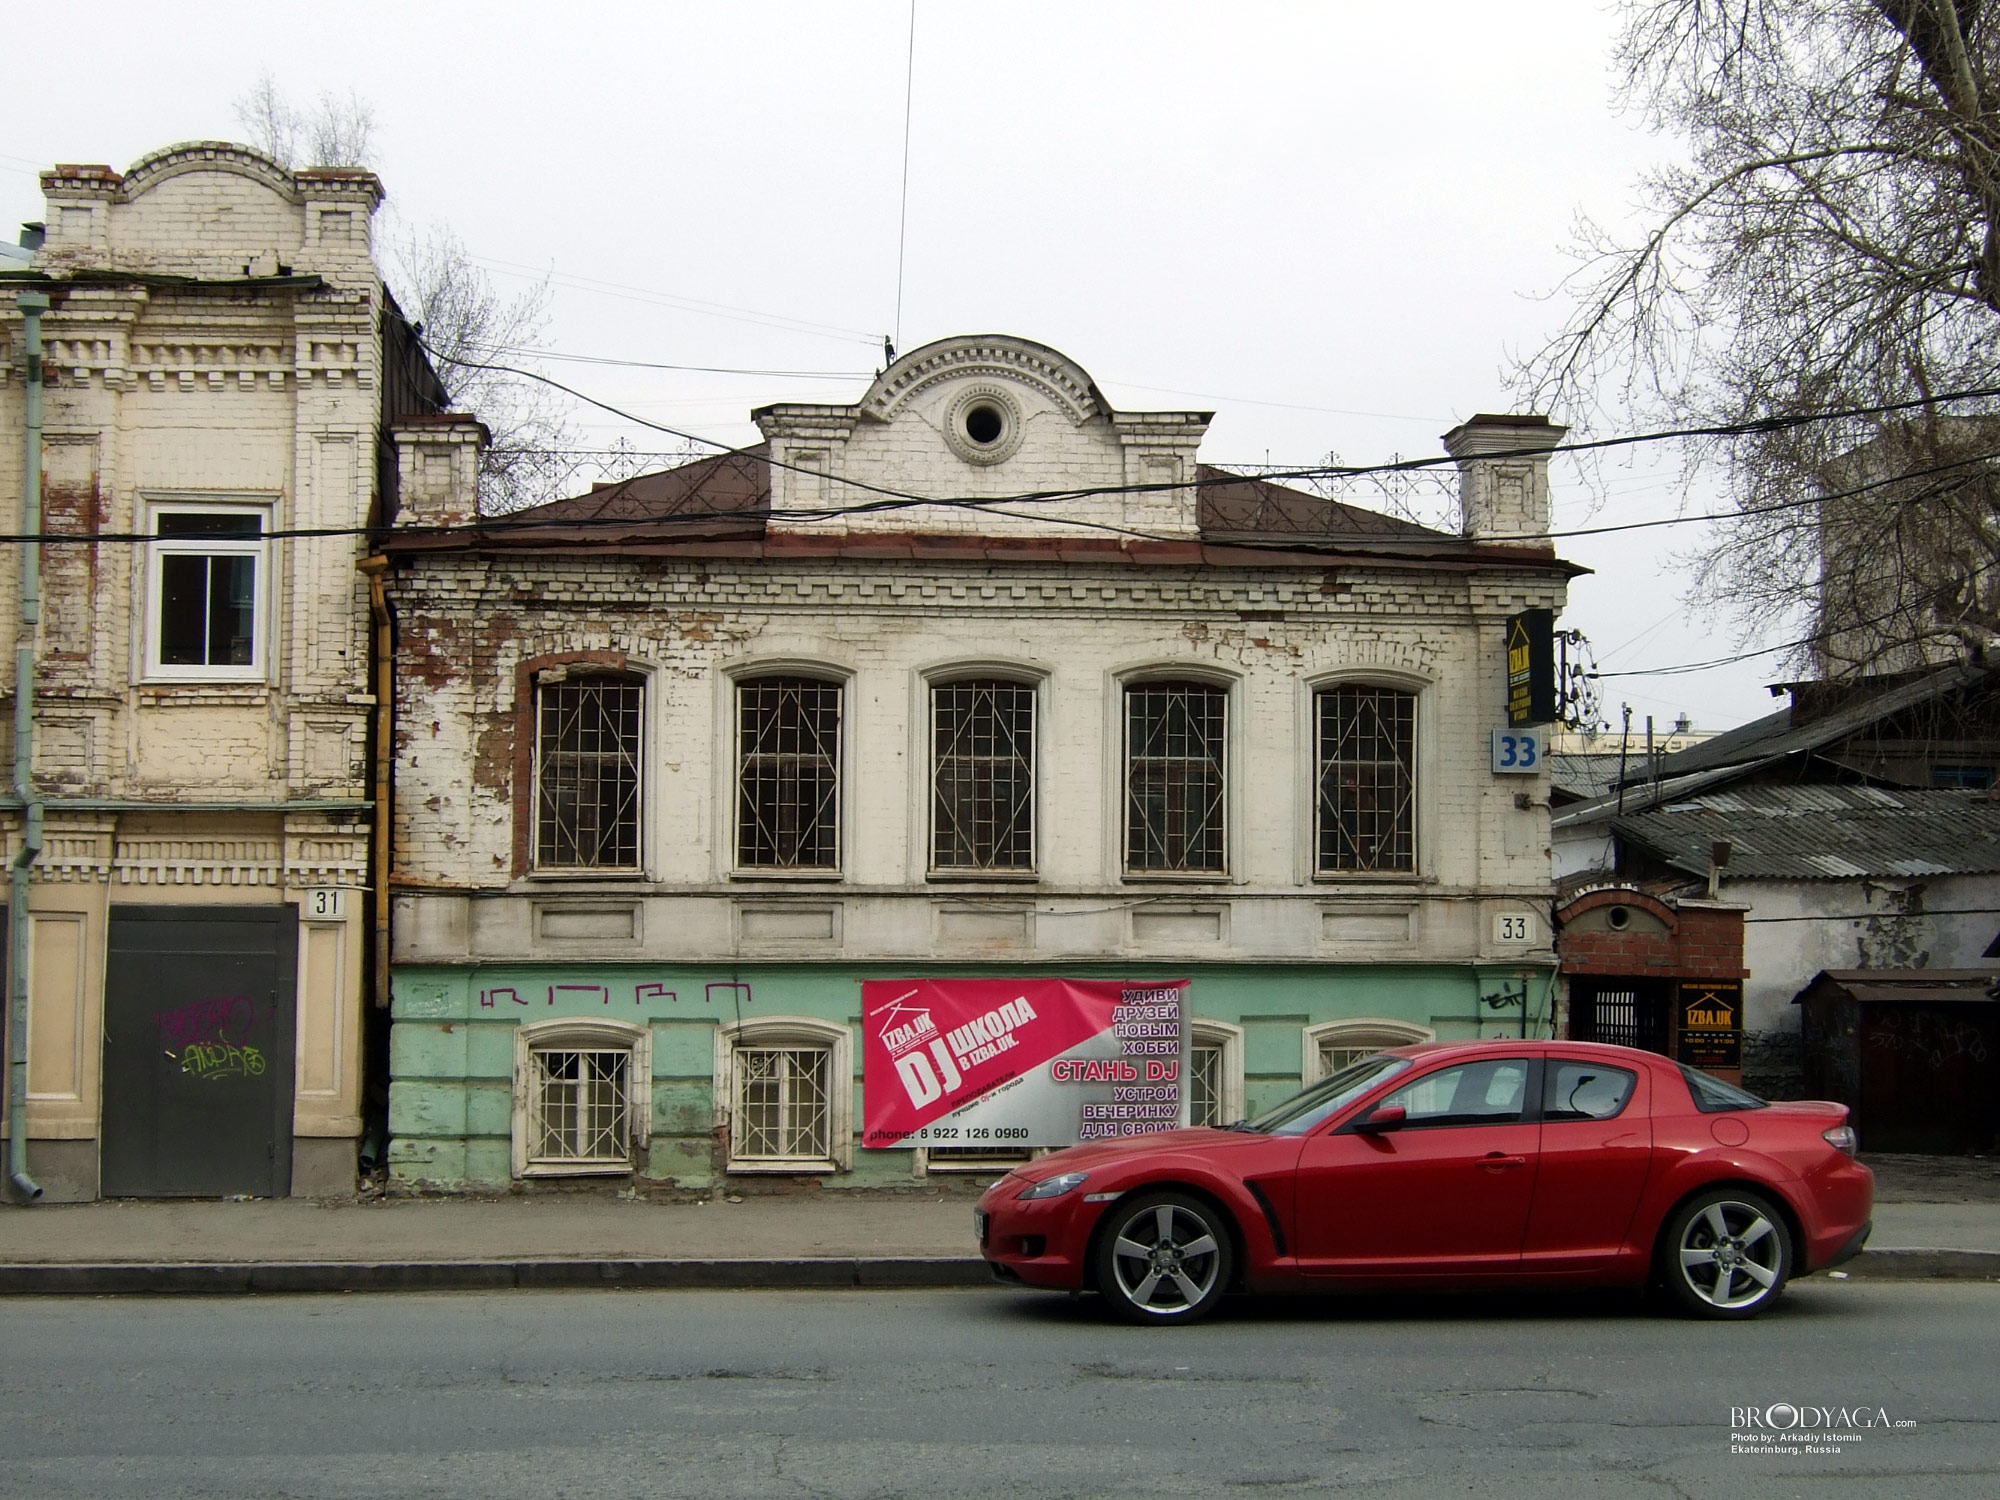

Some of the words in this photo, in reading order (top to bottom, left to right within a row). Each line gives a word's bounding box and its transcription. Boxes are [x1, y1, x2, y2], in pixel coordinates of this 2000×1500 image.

[1500, 736, 1536, 767] 33
[316, 891, 337, 914] 31
[1502, 918, 1525, 939] 33
[1122, 988, 1178, 1005] УДИВИ
[1112, 1003, 1179, 1022] ДРУЗЕЙ
[1687, 1010, 1732, 1025] IZBA.UK
[882, 1012, 936, 1051] IZBA.UK
[1115, 1023, 1179, 1038] НОВЫМ
[894, 1037, 962, 1110] DJ
[946, 996, 1037, 1057] ШКОЛА
[1123, 1040, 1179, 1055] ХОББИ
[1052, 1060, 1137, 1081] СТАНЬ
[1146, 1060, 1178, 1081] DJ
[998, 1077, 1024, 1095] города
[1114, 1084, 1178, 1101] УСТРОЙ
[1083, 1104, 1179, 1119] ВЕЧЕРИНКУ
[869, 1129, 915, 1142] phone:
[920, 1128, 928, 1139] 8
[933, 1128, 959, 1139] 922
[965, 1128, 989, 1139] 126
[994, 1128, 1029, 1139] 0980
[1080, 1122, 1117, 1139] ДЛЯ
